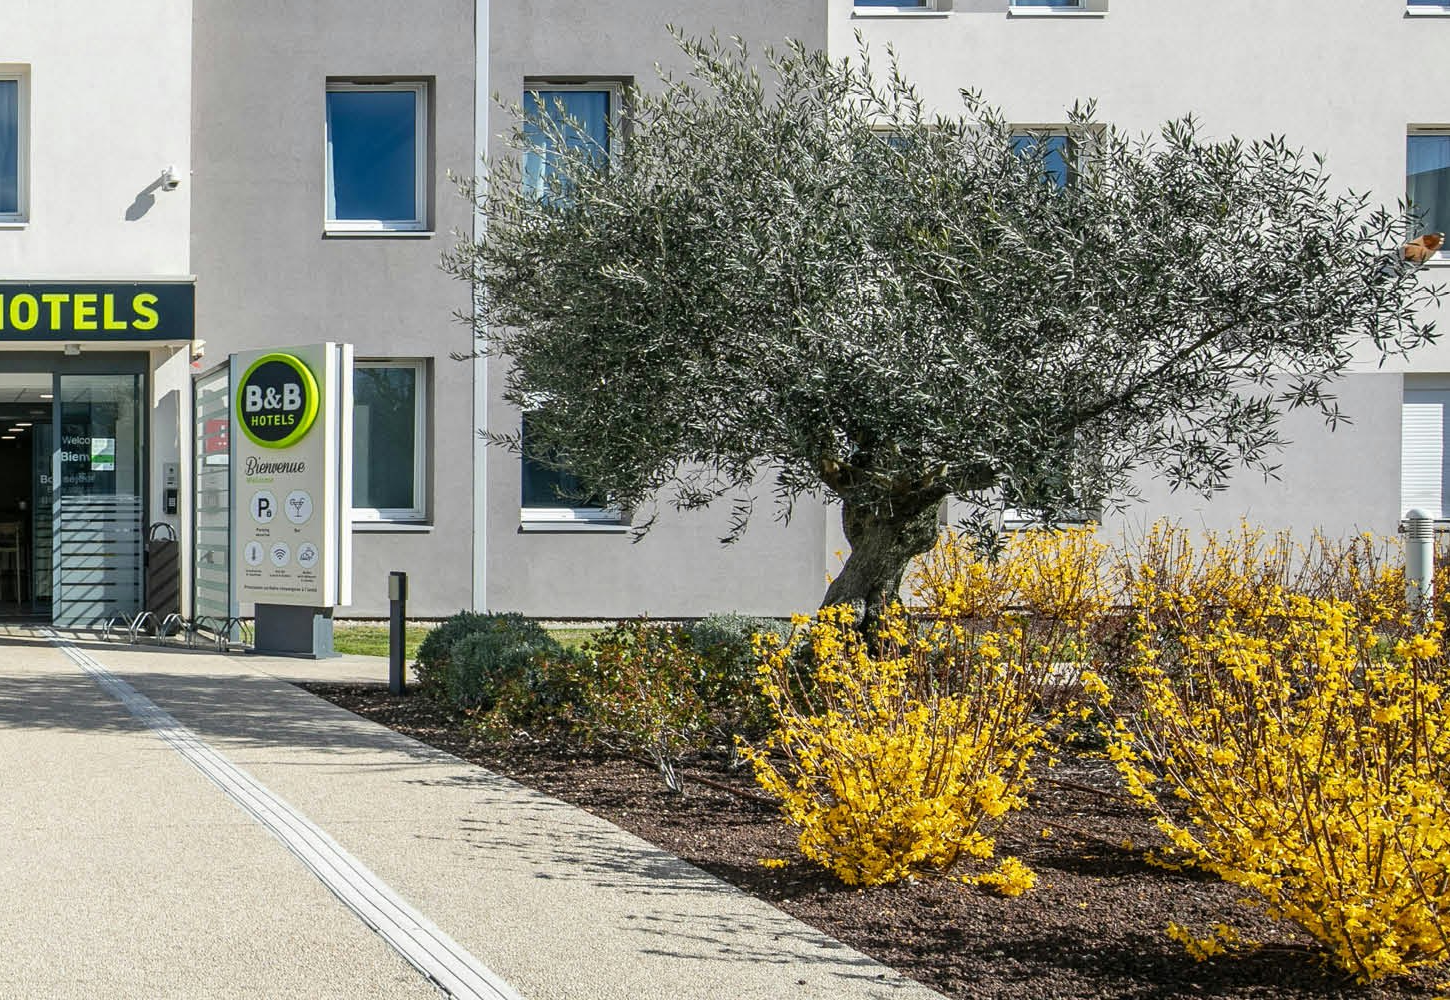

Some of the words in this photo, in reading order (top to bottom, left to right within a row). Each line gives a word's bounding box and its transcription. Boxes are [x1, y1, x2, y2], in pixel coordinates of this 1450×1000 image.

[245, 383, 301, 413] B&B
[251, 414, 295, 427] HOTELS
[61, 435, 91, 445] Welco
[245, 455, 306, 477] Bienvenue
